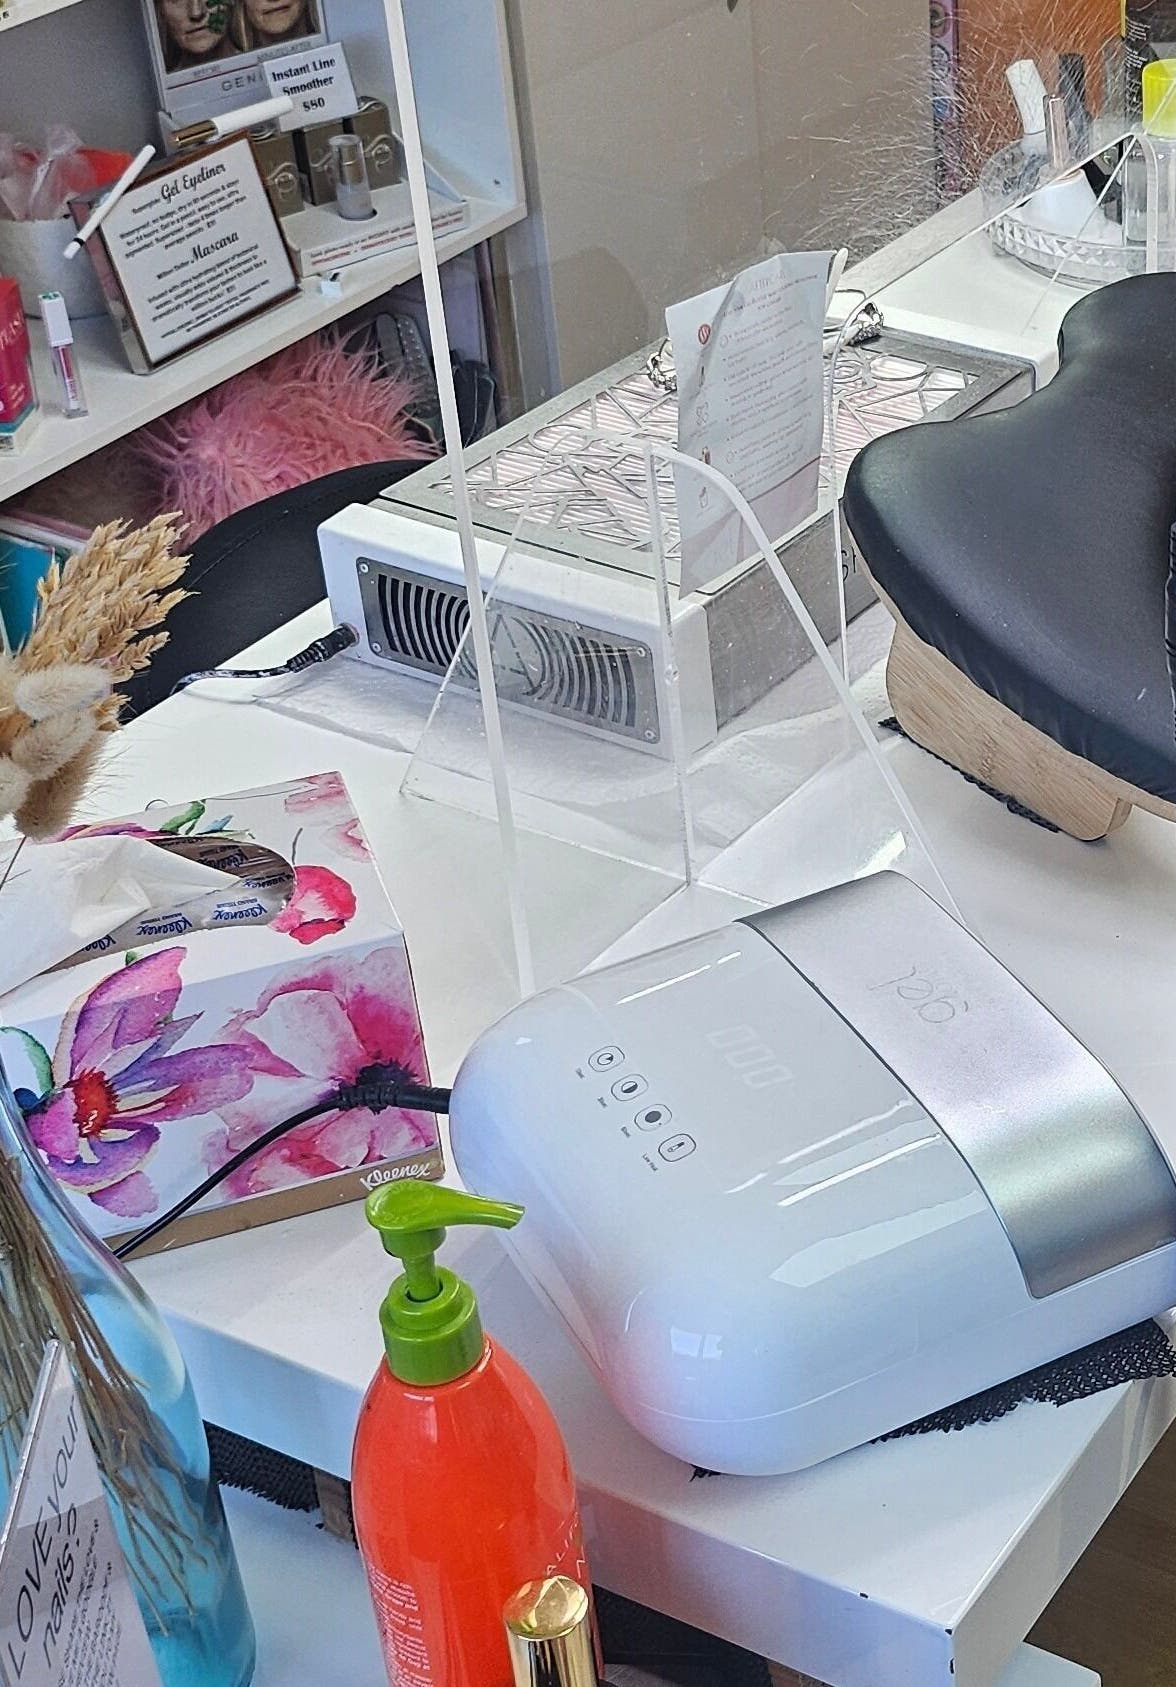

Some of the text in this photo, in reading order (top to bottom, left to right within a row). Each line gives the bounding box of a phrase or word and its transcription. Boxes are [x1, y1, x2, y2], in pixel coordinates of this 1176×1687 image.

[221, 72, 265, 92] GENI
[272, 58, 336, 82] Instant Line
[282, 76, 334, 96] Smoother
[160, 163, 226, 204] Gel Eyeliner
[191, 231, 240, 263] Mascara
[213, 903, 268, 921] Kleenex
[136, 916, 193, 936] Kleenex
[360, 1163, 431, 1191] Kleenex
[8, 1394, 79, 1680] LOVE your
